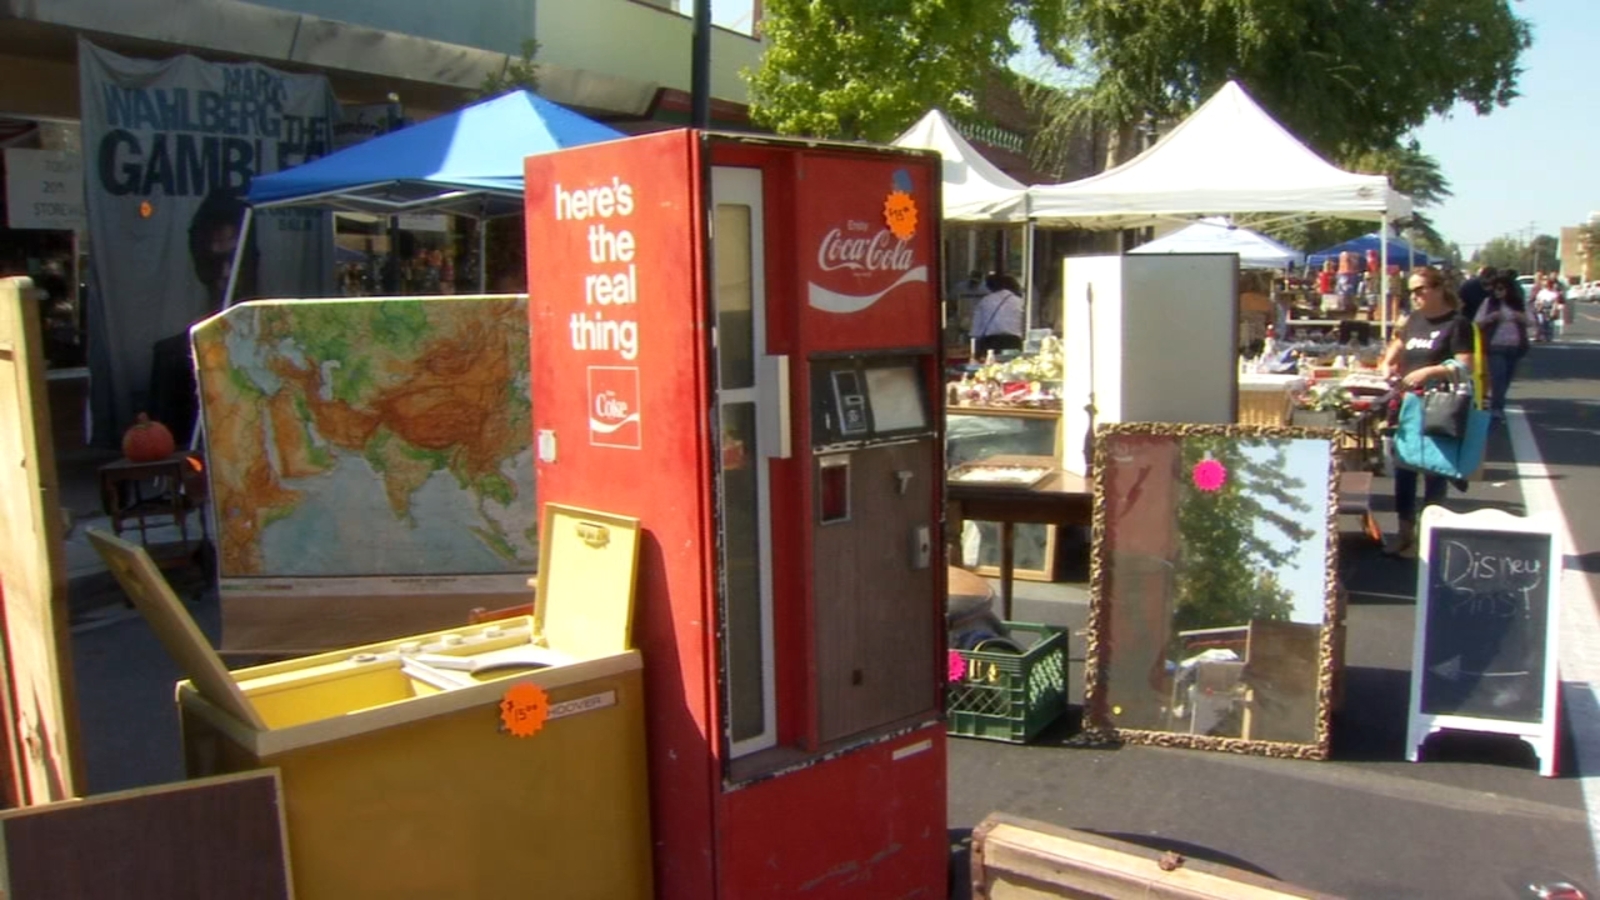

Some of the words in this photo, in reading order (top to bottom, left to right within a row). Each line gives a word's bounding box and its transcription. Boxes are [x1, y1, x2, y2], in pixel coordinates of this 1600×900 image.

[223, 67, 288, 106] MARK
[103, 83, 281, 137] WAHLBERG
[281, 115, 327, 145] THE
[554, 176, 635, 221] here's
[587, 223, 636, 264] the
[818, 228, 914, 271] Coca-Cola
[585, 263, 637, 306] real
[569, 310, 638, 360] thing
[595, 393, 628, 418] Coke
[1442, 540, 1543, 591] Disney
